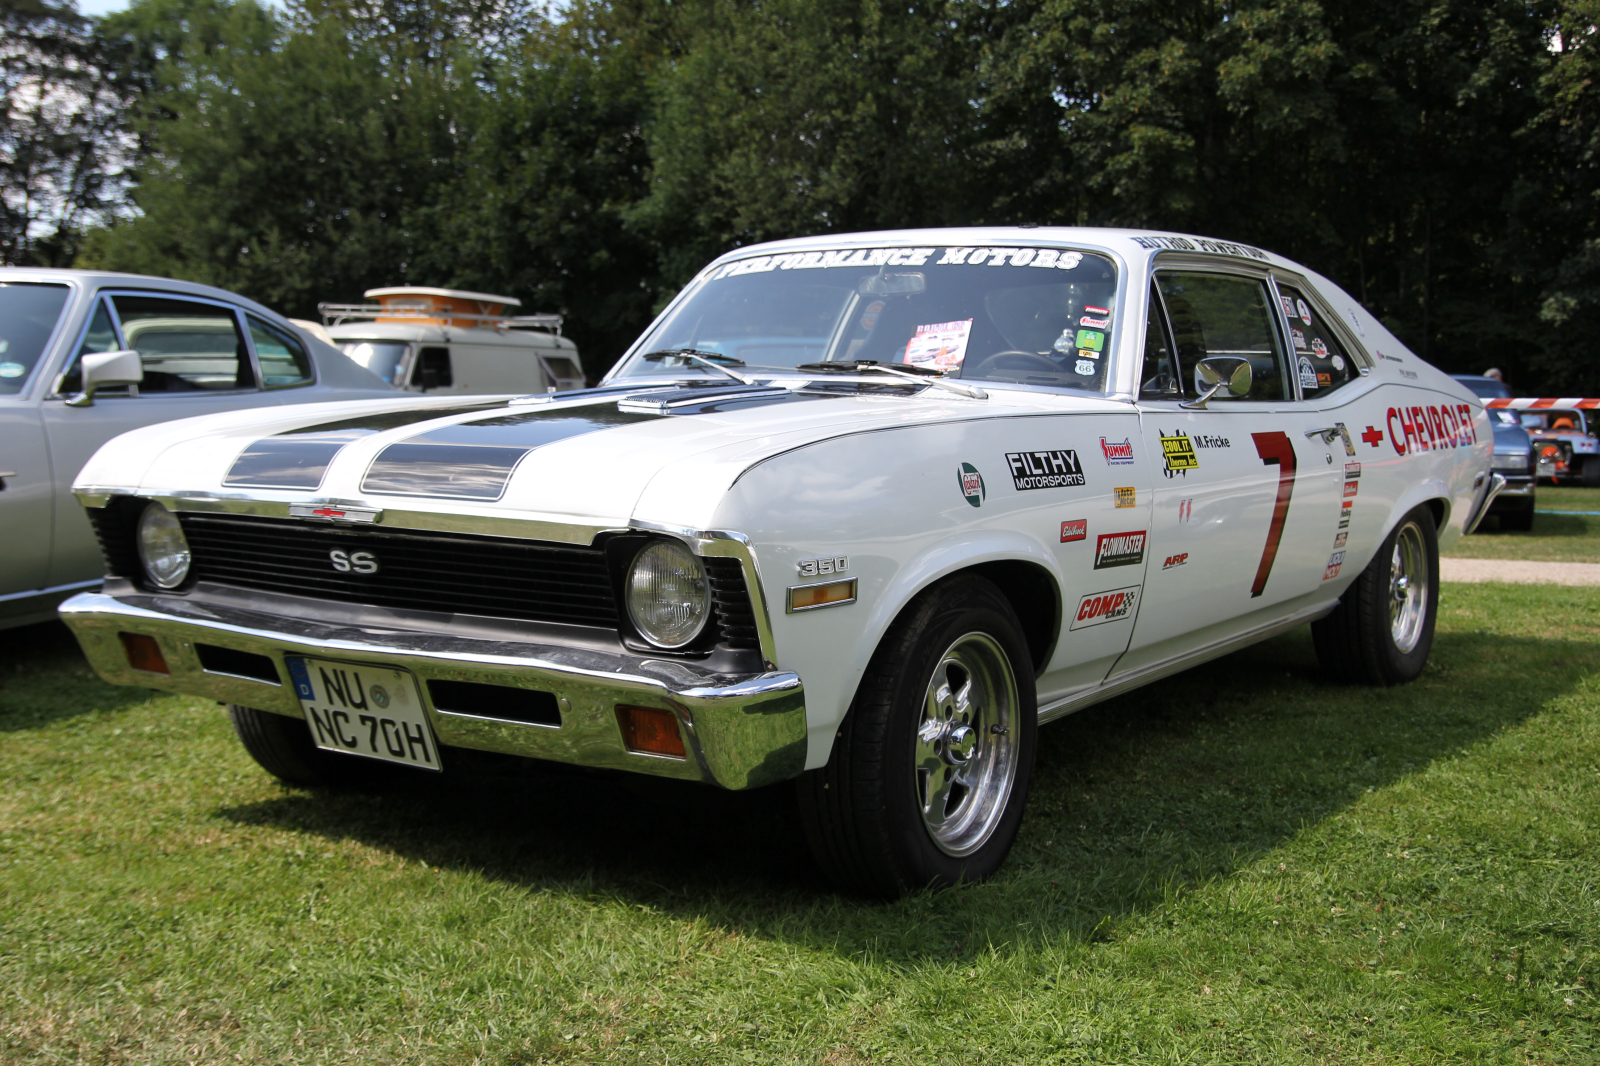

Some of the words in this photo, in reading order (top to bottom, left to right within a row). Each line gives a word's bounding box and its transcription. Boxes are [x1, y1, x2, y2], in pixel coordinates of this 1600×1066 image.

[713, 247, 936, 281] PERFORMANCE
[936, 247, 1083, 270] MOTORS
[1078, 365, 1092, 373] 66
[1193, 435, 1230, 449] M.Fricke
[1386, 404, 1477, 457] CHEVROLET
[1163, 440, 1182, 453] COOL
[1007, 450, 1078, 476] FILTHY
[1015, 473, 1085, 490] MOTORSPORTS
[1250, 431, 1297, 598] 7
[1062, 524, 1085, 538] Edelbrock
[329, 549, 379, 574] SS
[1096, 534, 1145, 566] FLOWMASTER
[1163, 552, 1188, 567] ARP
[798, 556, 850, 577] 350
[1077, 592, 1125, 622] COMP
[1105, 607, 1128, 619] CAMS
[300, 683, 309, 696] D
[319, 666, 369, 712] NU
[310, 706, 358, 749] NC
[360, 714, 431, 763] 70H
